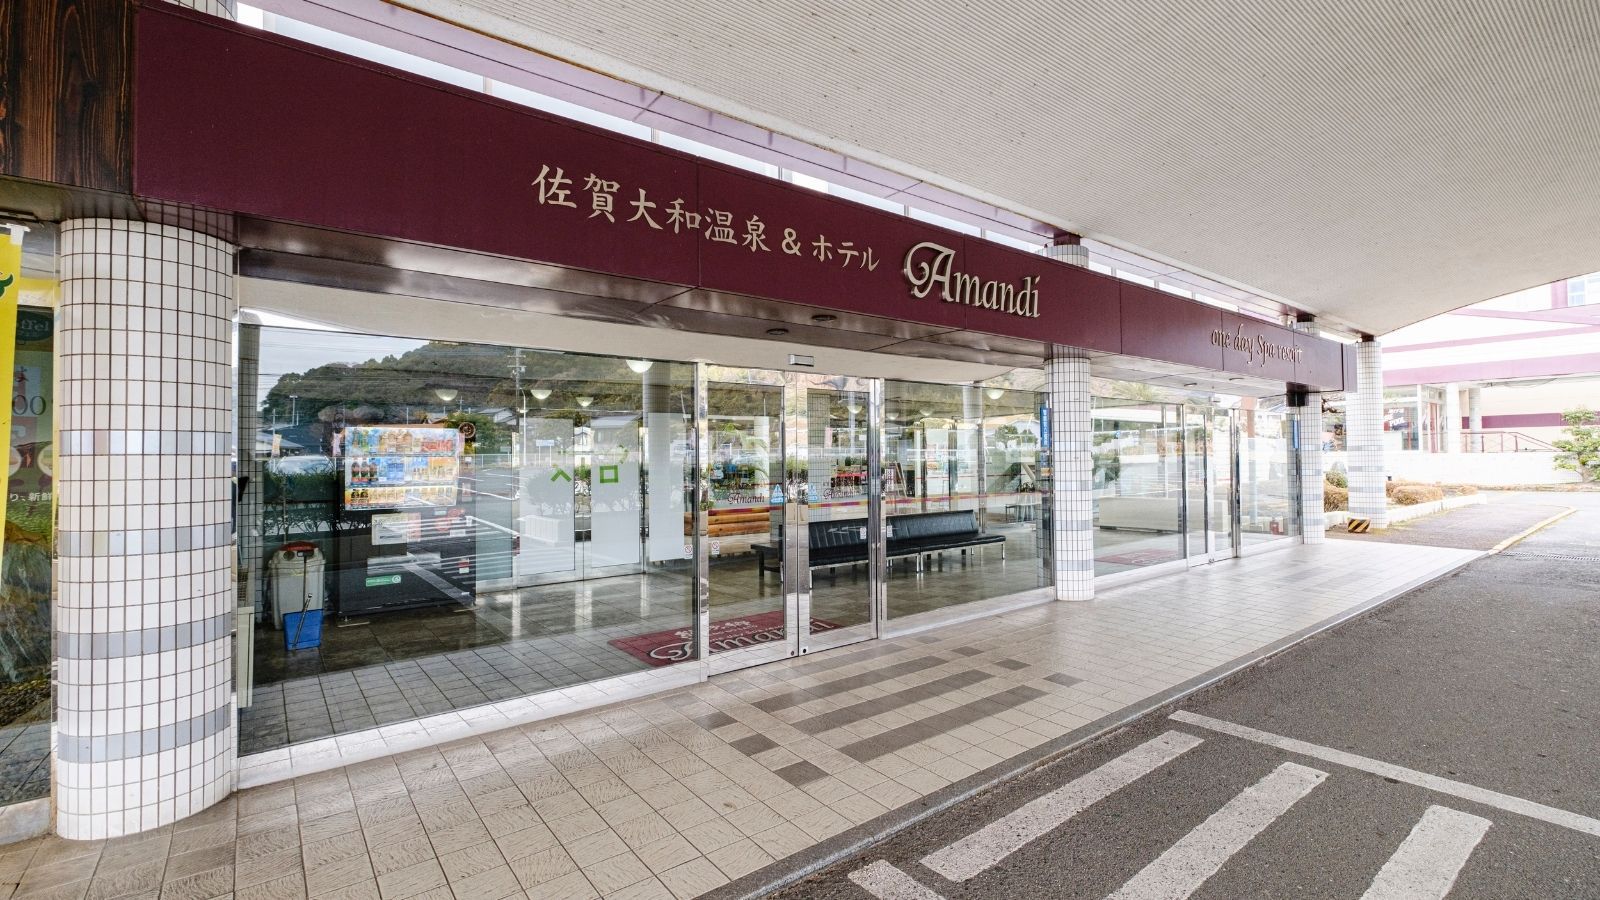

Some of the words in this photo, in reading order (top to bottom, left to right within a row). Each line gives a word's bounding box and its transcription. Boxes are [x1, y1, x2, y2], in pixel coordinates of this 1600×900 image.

[531, 164, 771, 252] 佐賀大和温泉
[781, 227, 802, 257] &
[811, 234, 881, 272] ホテル
[904, 241, 1041, 318] Amandi
[1211, 329, 1231, 349] one
[1233, 323, 1255, 365] day
[1256, 334, 1276, 368] Spa
[1277, 344, 1303, 364] resort
